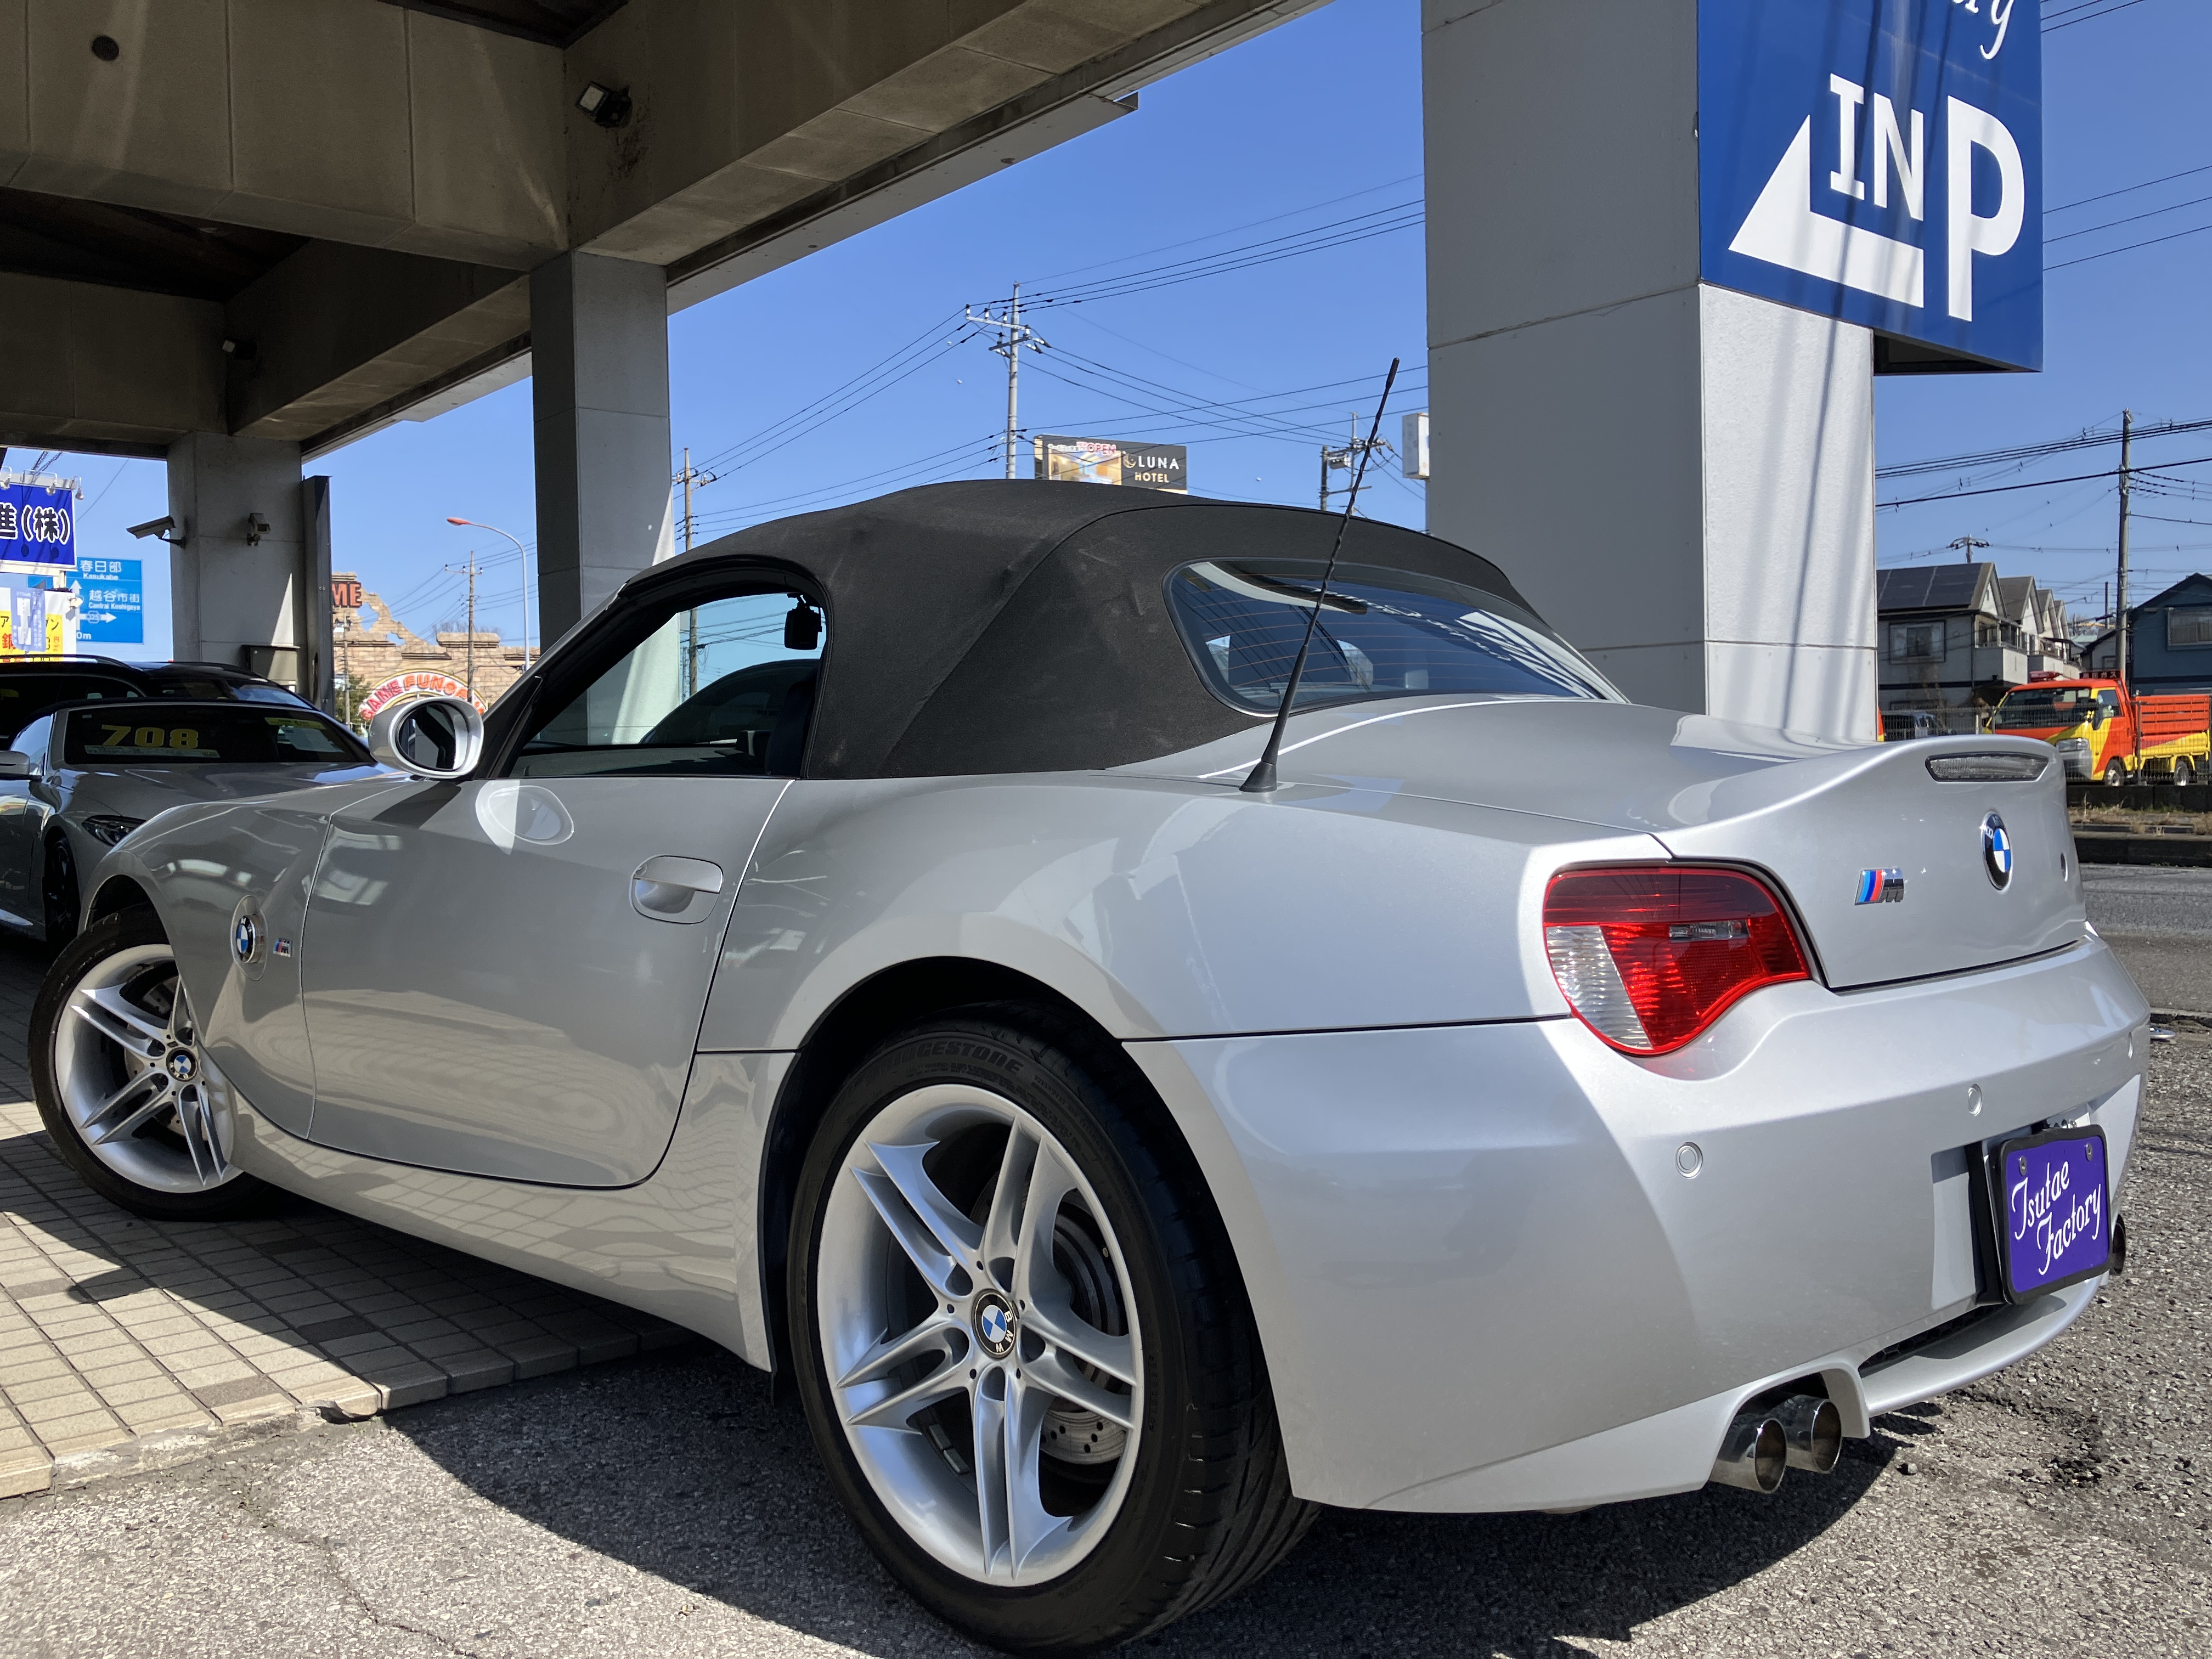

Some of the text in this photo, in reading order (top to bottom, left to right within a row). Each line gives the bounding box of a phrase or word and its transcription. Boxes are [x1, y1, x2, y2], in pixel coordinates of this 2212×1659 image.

[1830, 72, 2025, 322] IN P
[1087, 442, 1116, 456] OPEN
[1138, 455, 1180, 470] LUNA
[1135, 472, 1170, 483] HOTEL
[80, 560, 122, 573] 春日部
[89, 590, 139, 603] 越谷市街
[111, 603, 140, 611] Koshigaya
[360, 679, 403, 720] GAME
[101, 724, 199, 749] 708
[2037, 1183, 2101, 1276] Factory
[995, 1310, 1014, 1353] BMW
